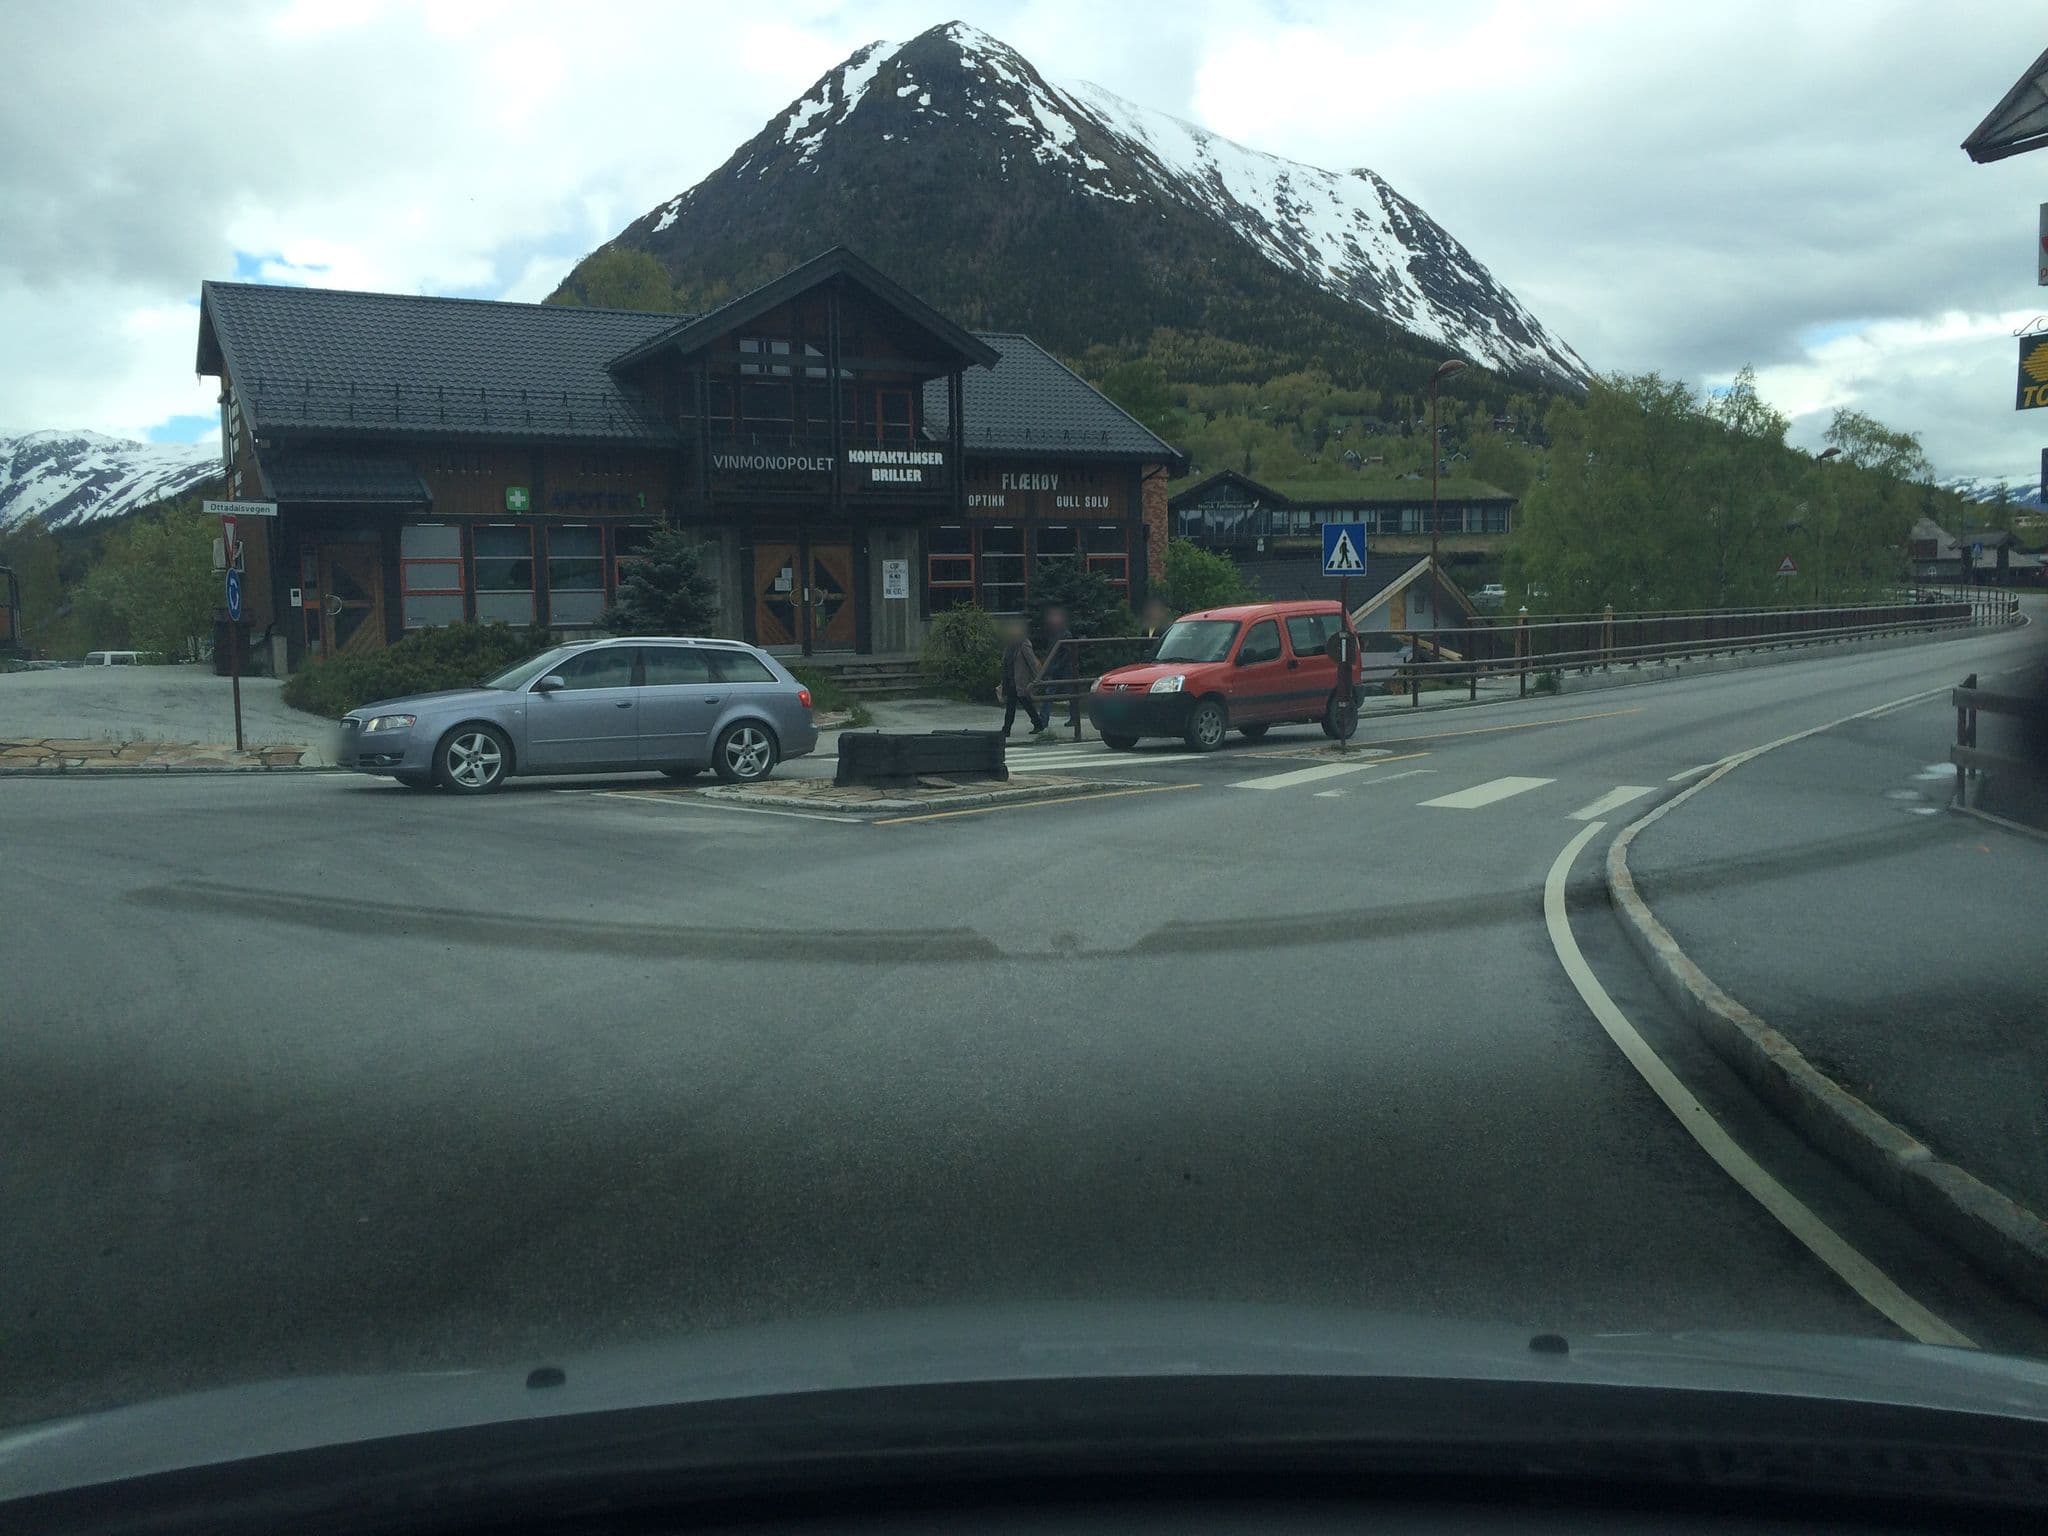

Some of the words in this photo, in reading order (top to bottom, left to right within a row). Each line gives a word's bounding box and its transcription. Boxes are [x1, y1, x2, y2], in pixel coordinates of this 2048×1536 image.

[713, 455, 834, 471] VINMONOPOLET
[848, 450, 943, 465] KONTAKTLINSER
[872, 468, 922, 482] BRILLER
[1002, 473, 1059, 491] FLÆKØY
[968, 494, 1005, 507] OPTIKK
[210, 503, 271, 513] Ottadalsvegen
